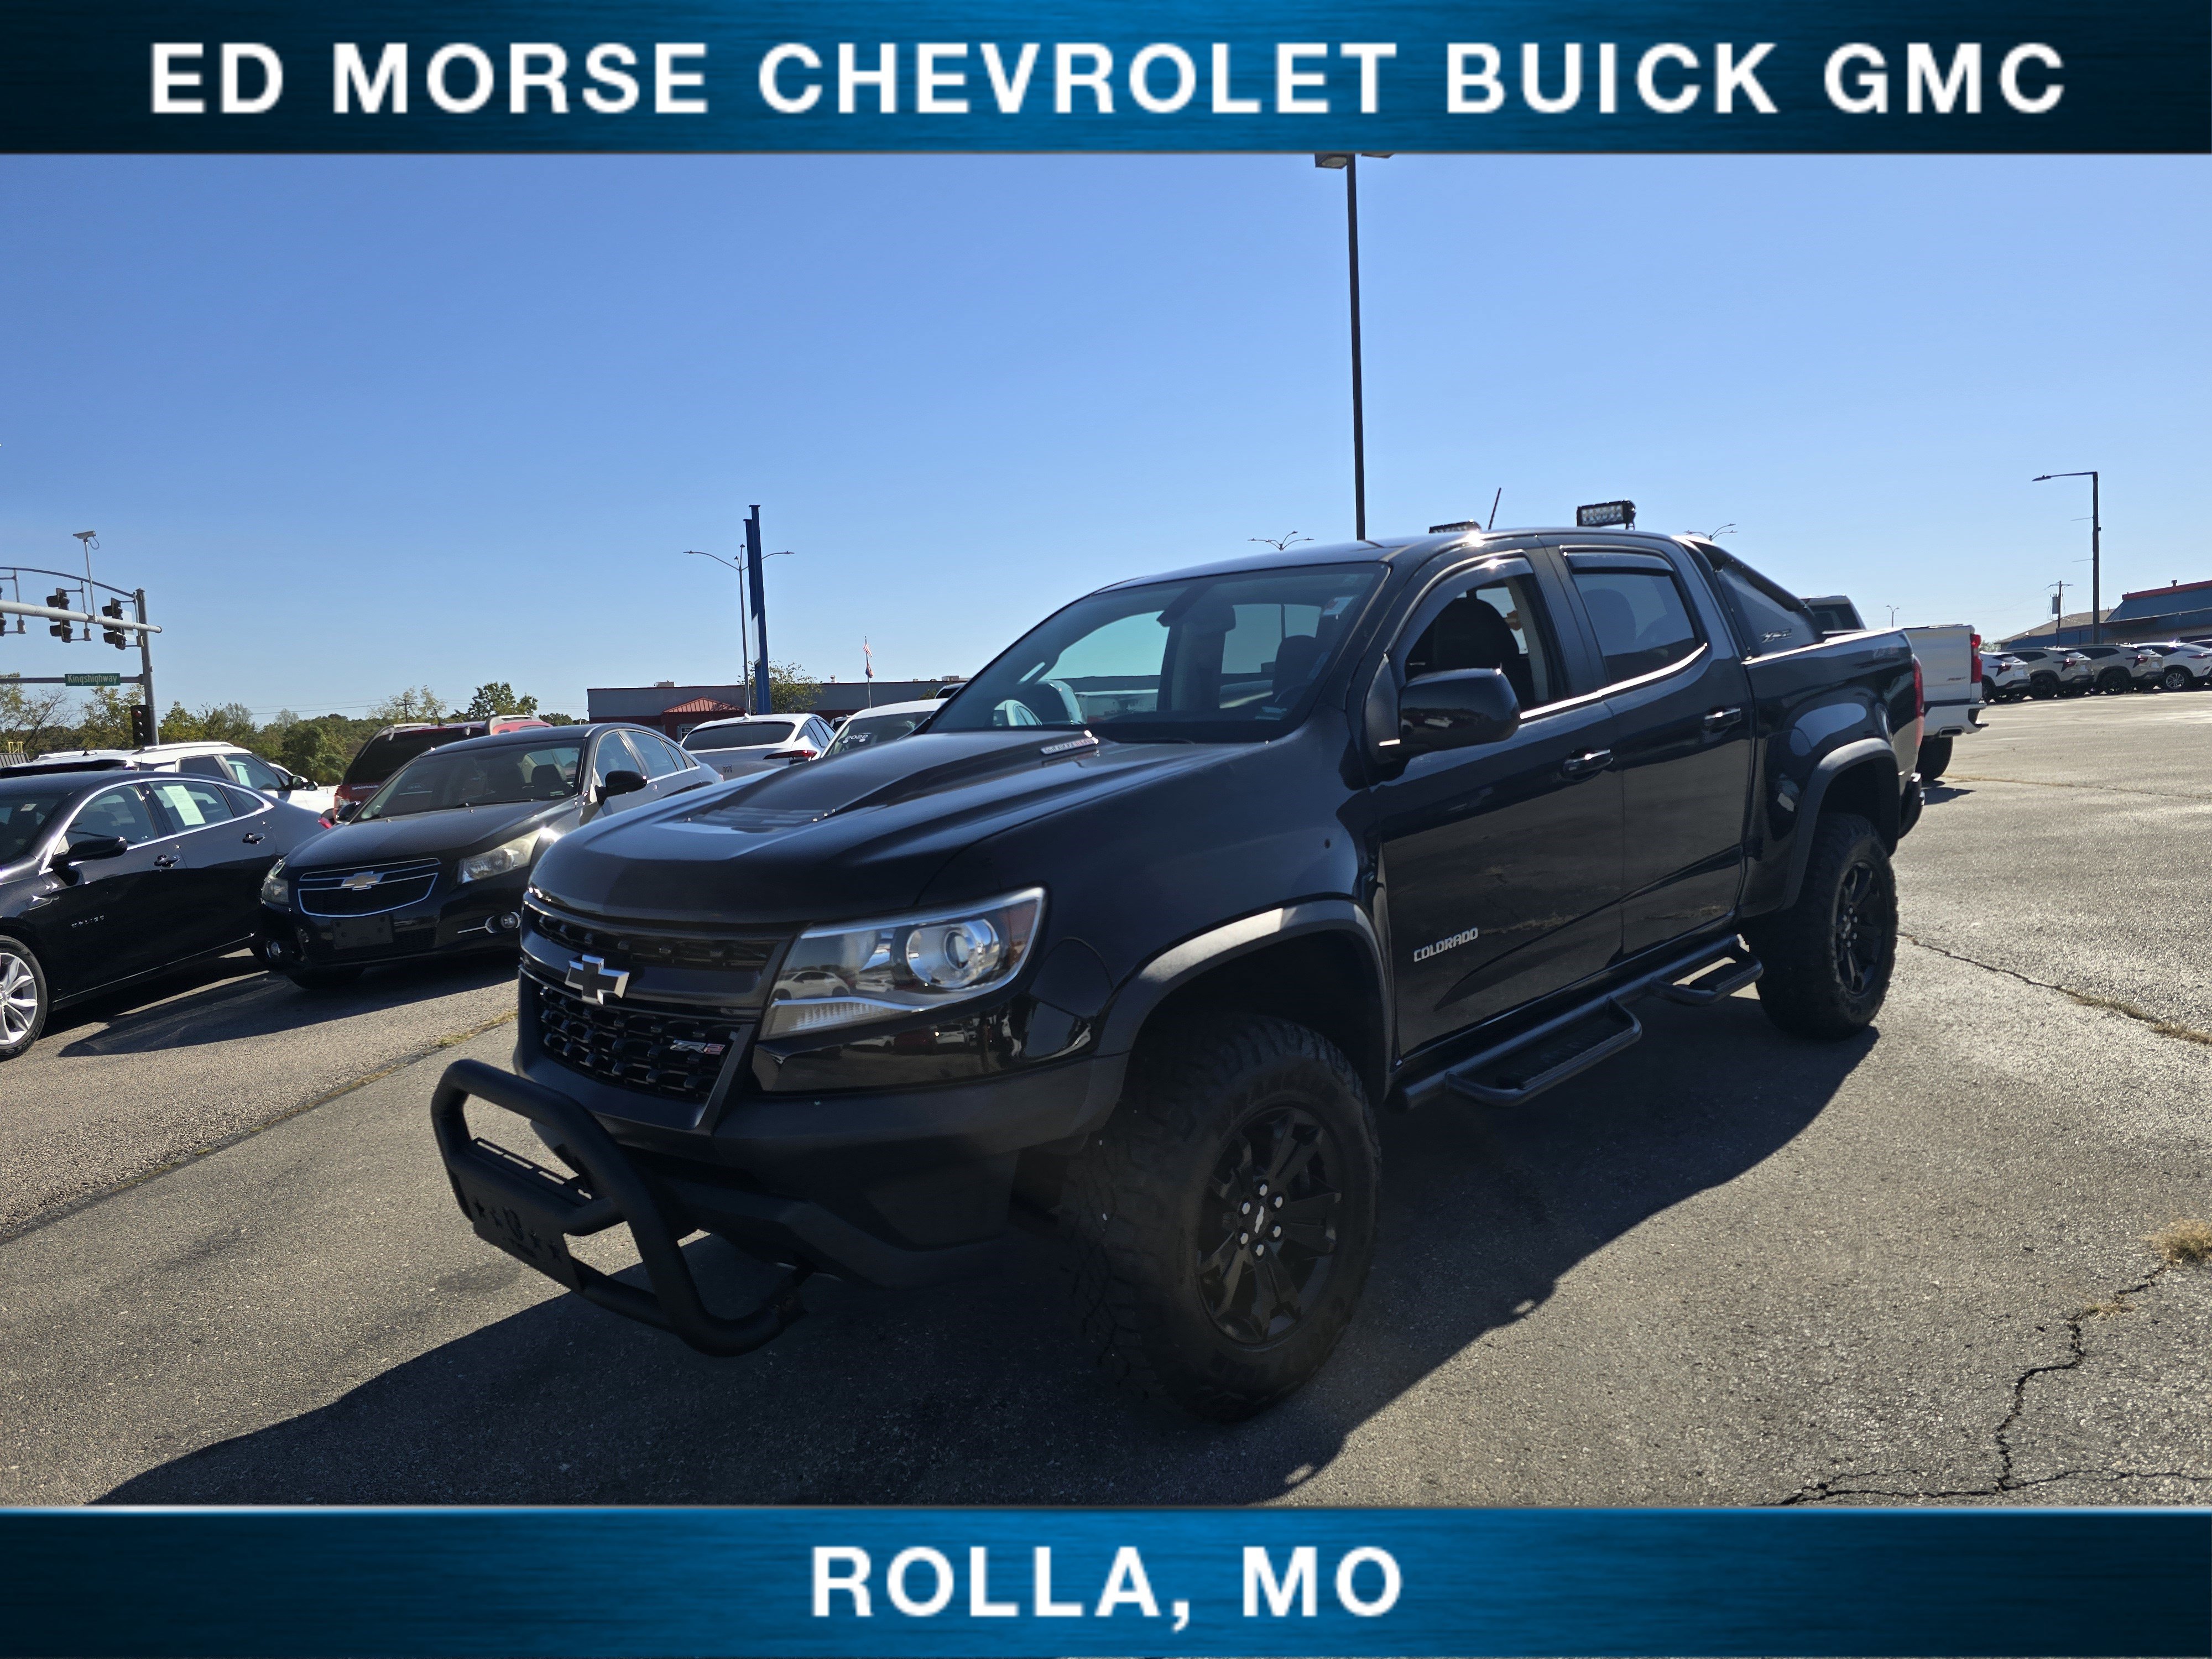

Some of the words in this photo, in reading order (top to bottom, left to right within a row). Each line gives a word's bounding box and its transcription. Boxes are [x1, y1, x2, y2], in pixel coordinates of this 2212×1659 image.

[67, 674, 118, 685] Kingshighway
[1413, 927, 1479, 962] COLORADO
[670, 1040, 726, 1055] ZR2
